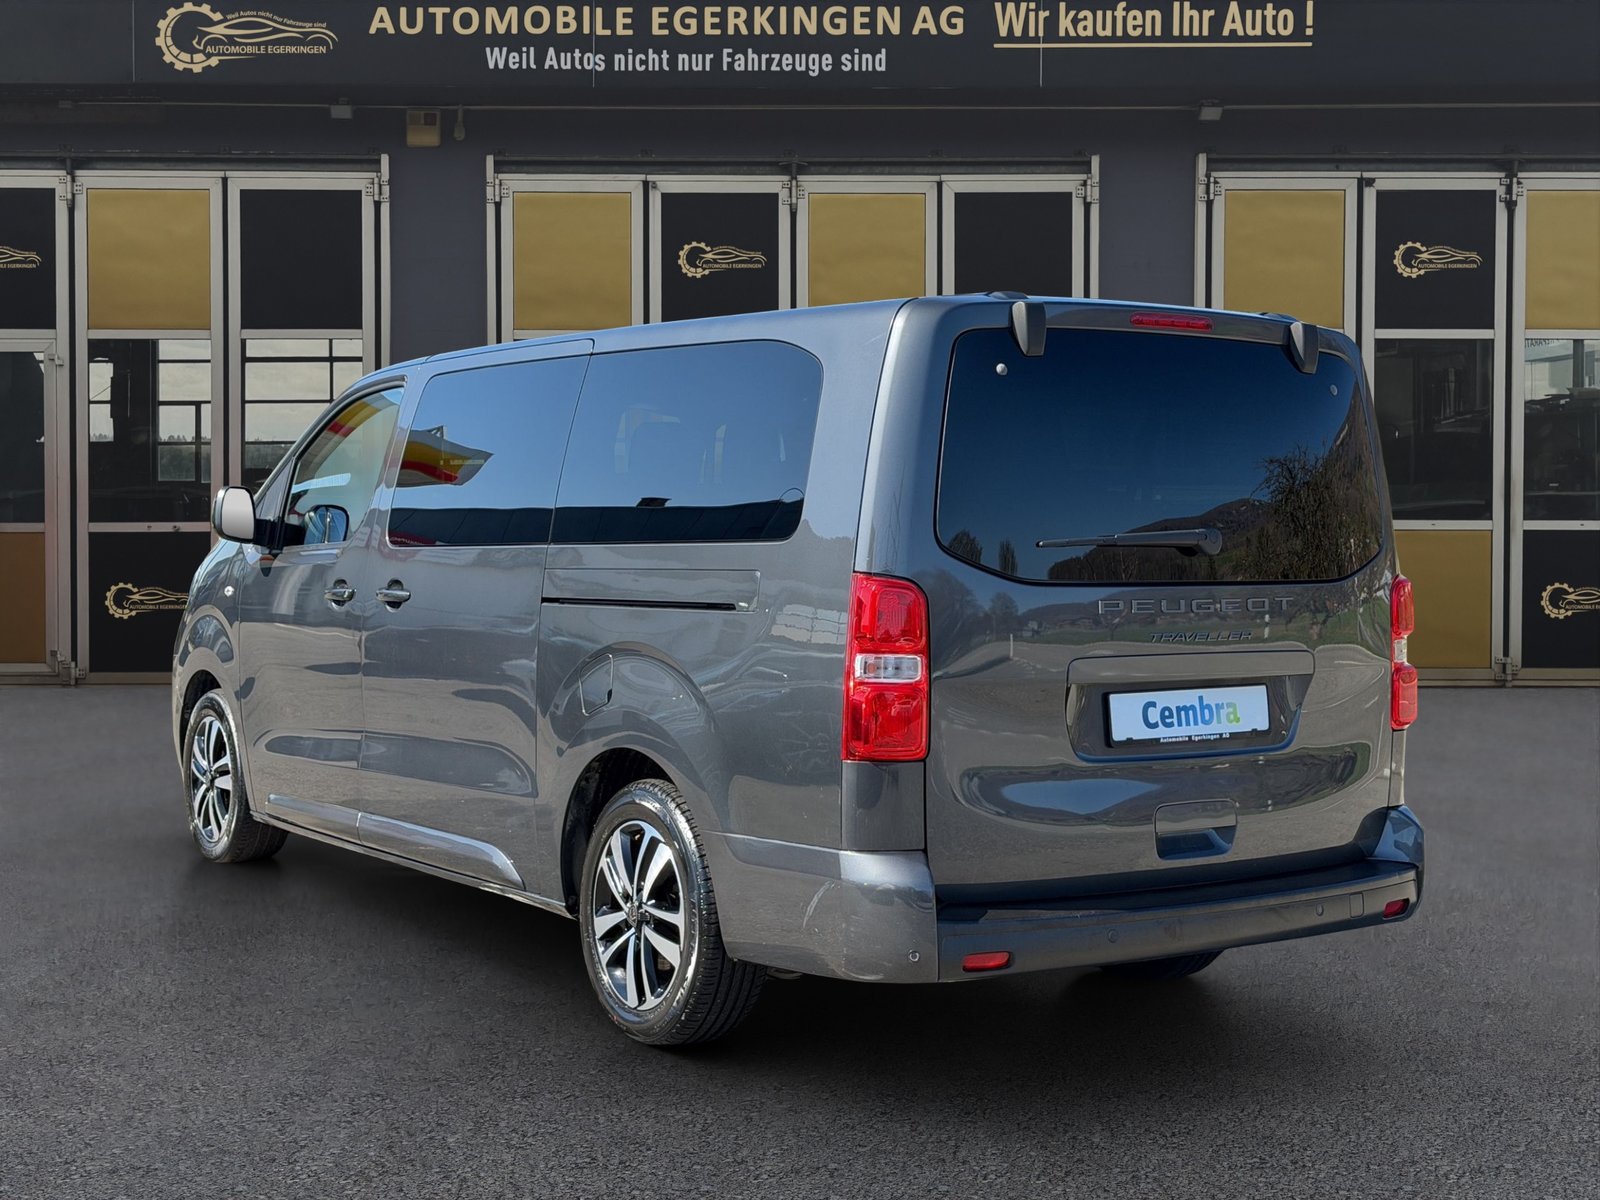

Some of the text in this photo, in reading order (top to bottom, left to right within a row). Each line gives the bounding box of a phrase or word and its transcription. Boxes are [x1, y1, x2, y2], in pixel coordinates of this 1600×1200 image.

[369, 6, 965, 36] AUTOMOBILE EGERKINGEN AG
[994, 1, 1050, 37] Wir
[1058, 1, 1162, 37] kaufen
[1172, 1, 1215, 36] Ihr
[1222, 1, 1295, 36] Auto
[205, 45, 327, 54] AUTOMOBILE EGERKINGEN
[485, 47, 887, 77] Weil Autos nicht nur Fahrzeuge sind
[1098, 597, 1294, 615] PEUGEOT
[1150, 631, 1253, 643] TRAVELLER
[1141, 695, 1241, 730] Cembra
